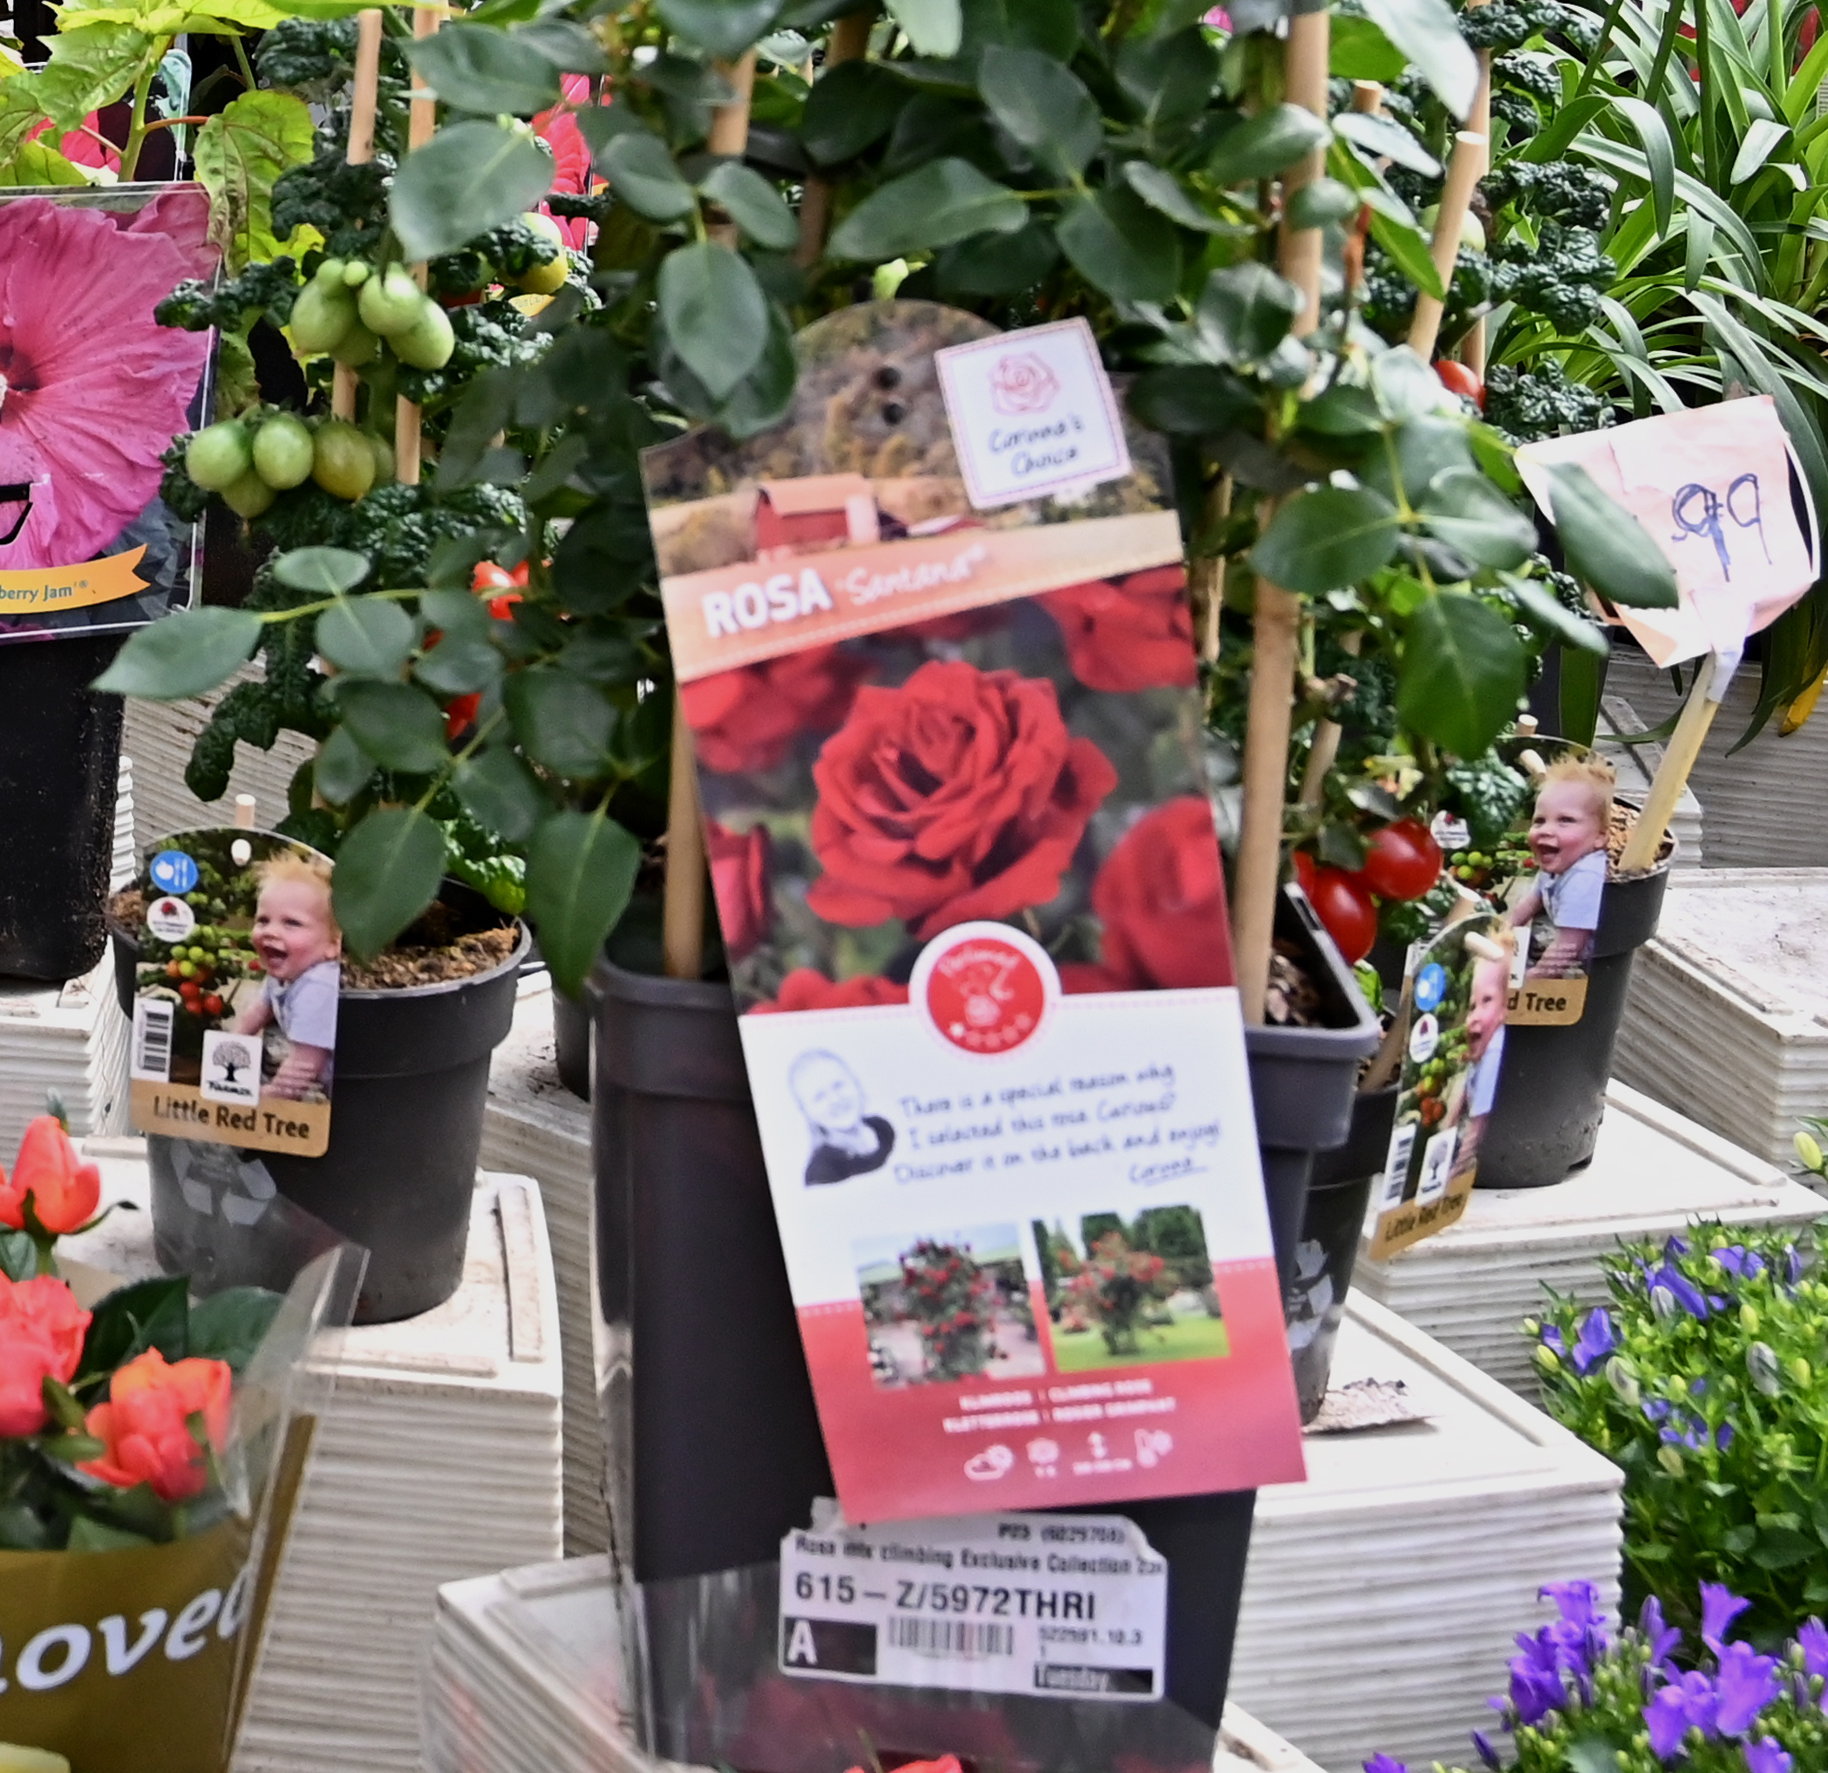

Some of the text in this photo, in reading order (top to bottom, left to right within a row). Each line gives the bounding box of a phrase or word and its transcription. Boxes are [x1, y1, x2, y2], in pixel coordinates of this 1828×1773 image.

[700, 567, 834, 639] ROSA
[1524, 991, 1567, 1013] Tree
[153, 1095, 310, 1139] Little Red Tree
[1384, 1211, 1415, 1242] Little
[1418, 1200, 1441, 1225] Red
[1440, 1187, 1464, 1214] Tree
[795, 1571, 856, 1605] 615
[787, 1620, 818, 1665] A
